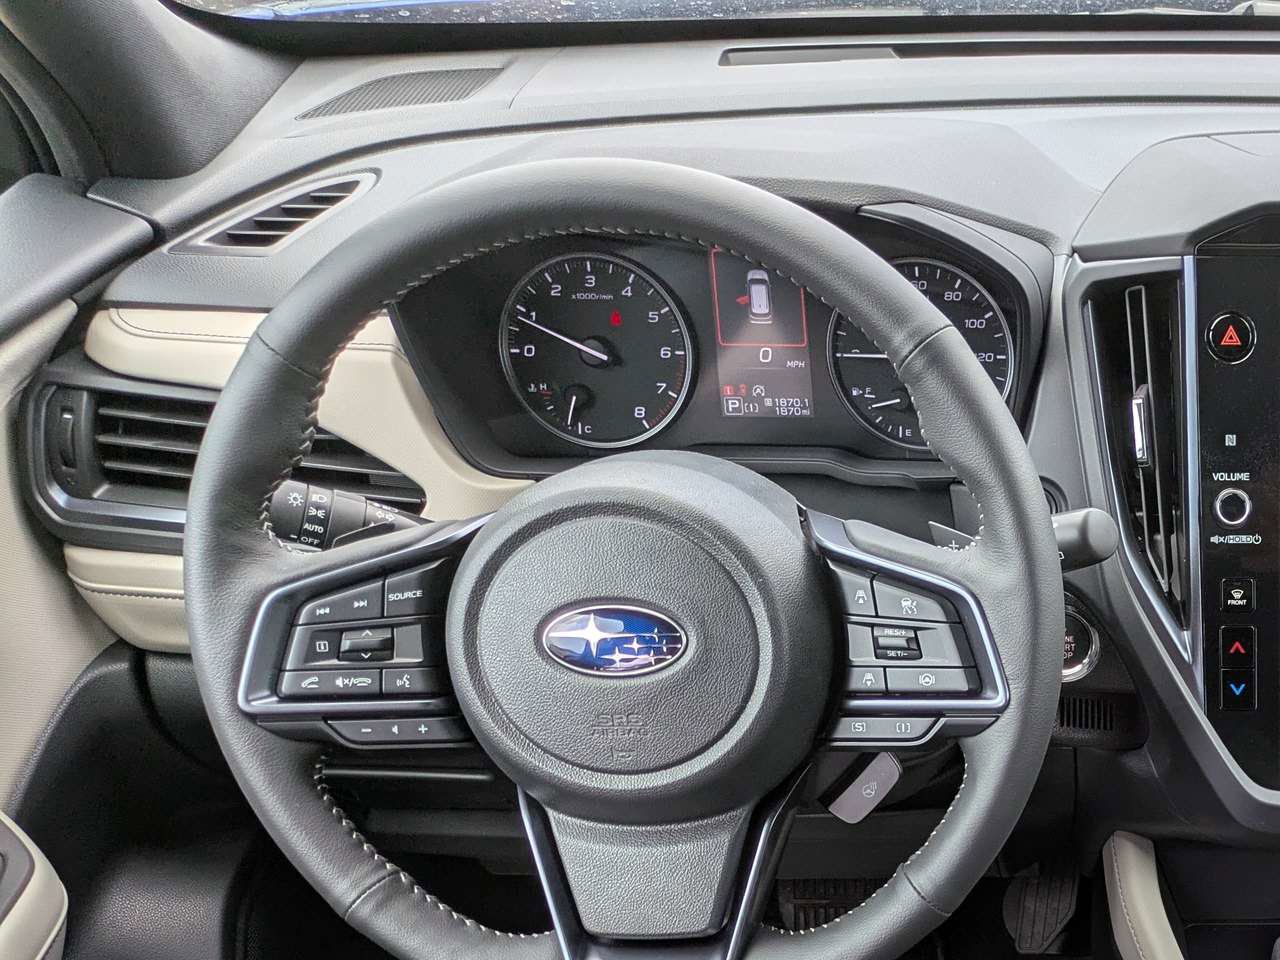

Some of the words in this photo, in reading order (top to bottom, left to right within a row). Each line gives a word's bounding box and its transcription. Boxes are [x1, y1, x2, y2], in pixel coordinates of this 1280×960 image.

[585, 276, 595, 286] 3
[550, 285, 562, 296] 2
[622, 286, 632, 297] 4
[944, 292, 962, 301] 80
[530, 312, 536, 322] 1
[648, 312, 658, 322] 5
[964, 319, 986, 329] 100
[524, 345, 536, 357] 0
[660, 347, 672, 358] 6
[759, 348, 772, 363] 0
[976, 353, 994, 362] 20
[656, 383, 666, 394] 7
[728, 400, 740, 412] P
[774, 398, 808, 406] 1870.1
[634, 406, 646, 418] 8
[1212, 472, 1250, 481] VOLUME
[304, 523, 324, 534] AUTO
[300, 537, 320, 545] OFF
[388, 590, 423, 601] SOURCE
[597, 714, 644, 726] SRS
